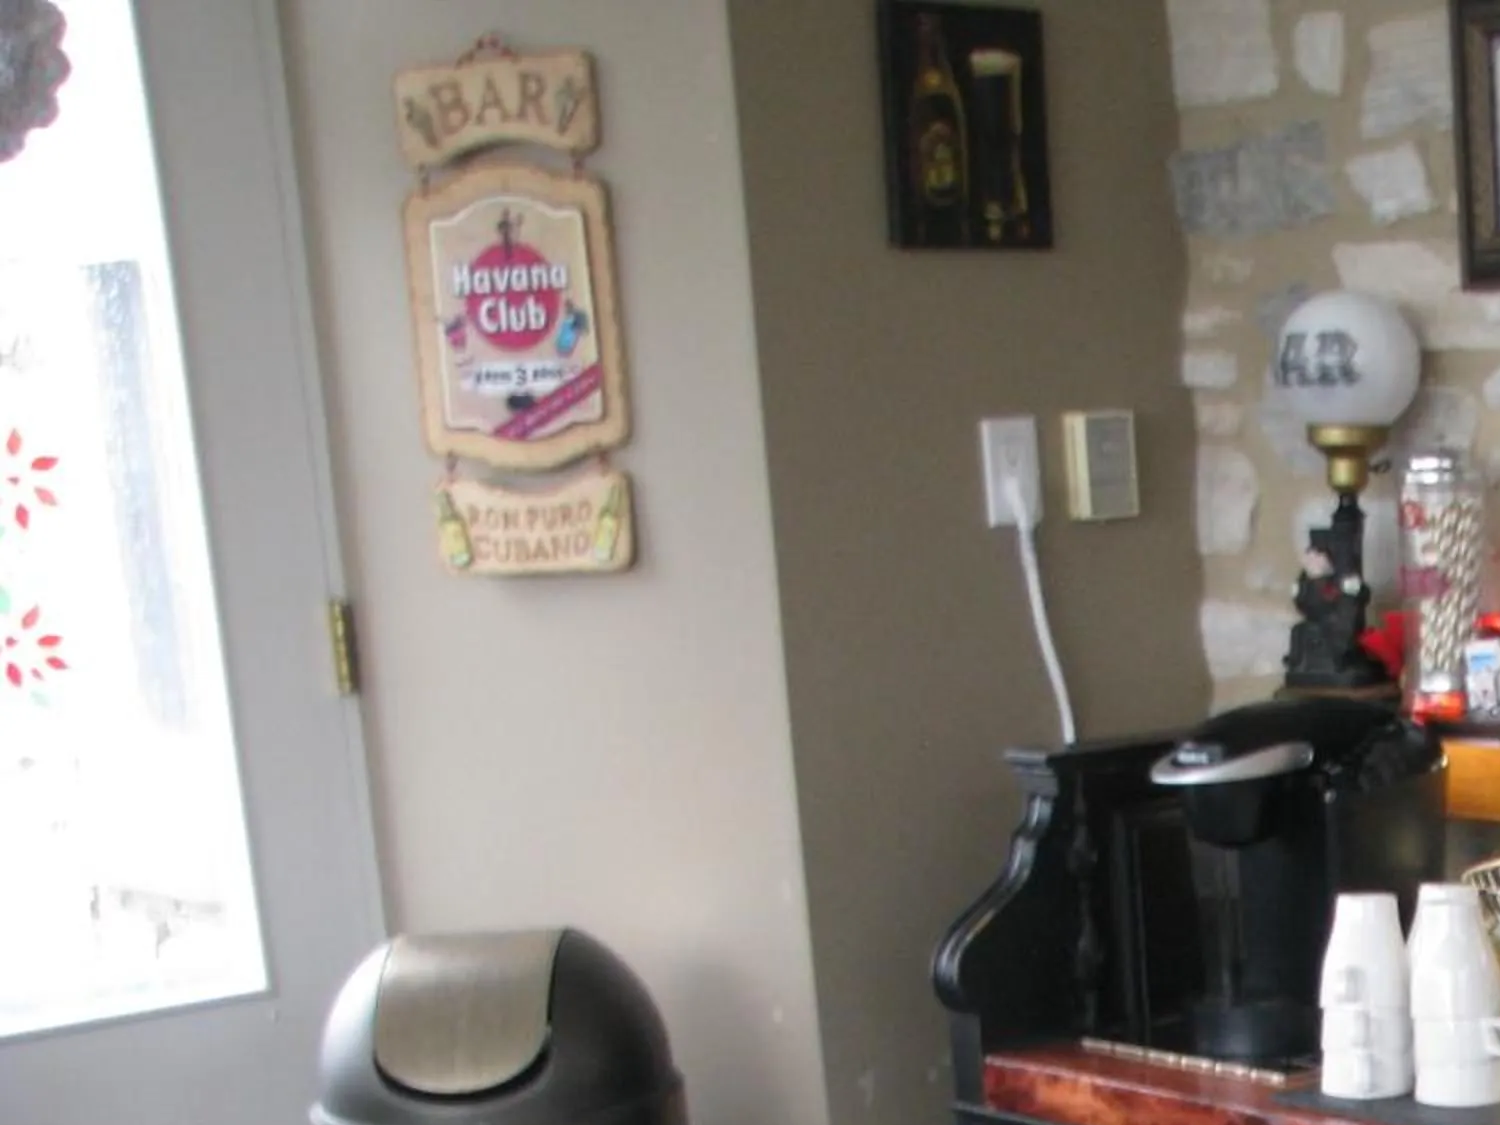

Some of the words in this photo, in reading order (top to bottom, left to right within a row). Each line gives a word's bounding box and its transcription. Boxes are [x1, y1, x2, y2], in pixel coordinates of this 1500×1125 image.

[428, 71, 550, 136] BAR
[452, 262, 568, 298] Havana
[479, 297, 548, 334] Club
[474, 530, 590, 563] CUBANO
